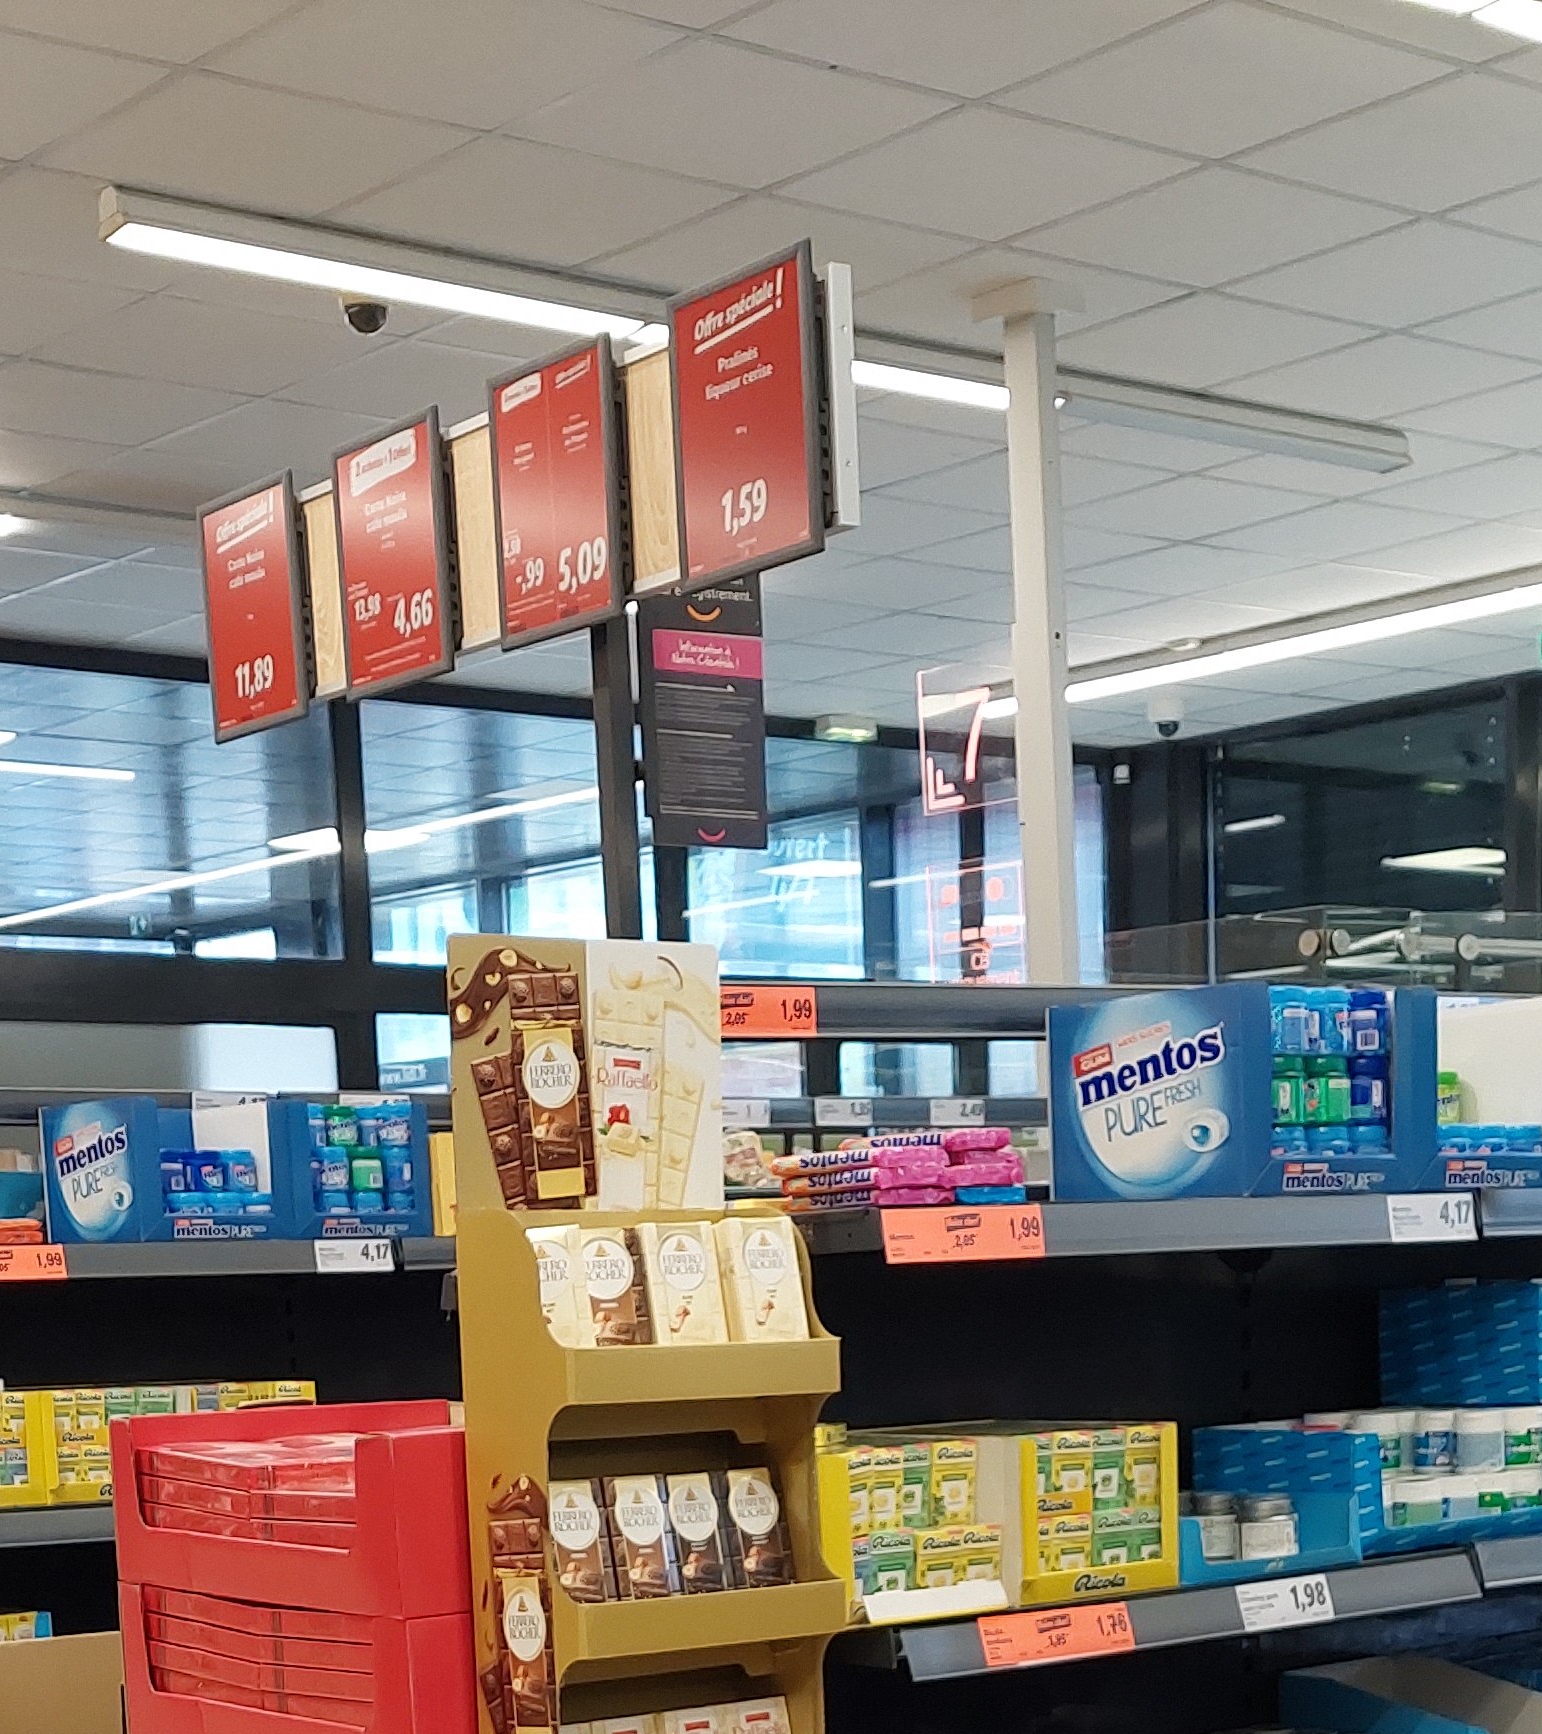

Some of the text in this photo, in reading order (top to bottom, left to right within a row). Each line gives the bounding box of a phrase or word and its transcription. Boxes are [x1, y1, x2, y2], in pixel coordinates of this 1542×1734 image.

[721, 478, 768, 536] 1,59
[558, 537, 607, 593] 5,09
[392, 588, 434, 638] 4,66
[234, 654, 274, 700] 11,89
[955, 686, 992, 782] 7
[781, 998, 813, 1022] 1,99
[596, 1066, 658, 1092] Raffaello
[1079, 1030, 1222, 1107] mentos
[1104, 1077, 1202, 1142] PURE FRESH
[59, 1128, 126, 1178] mentos
[799, 1150, 870, 1169] mentos
[71, 1170, 104, 1205] PURE
[808, 1169, 872, 1188] mentos
[1285, 1171, 1344, 1190] mentos
[1447, 1168, 1501, 1187] mentos
[1439, 1200, 1472, 1228] 4,17
[176, 1226, 229, 1237] mentos
[325, 1225, 373, 1236] mentos
[1009, 1216, 1041, 1241] 1,99
[360, 1242, 390, 1263] 4,17
[62, 1431, 95, 1443] Ricola
[1057, 1437, 1092, 1450] Ricola
[937, 1446, 974, 1461] Ricola
[1055, 1520, 1090, 1534] Ricola
[873, 1531, 1000, 1551] Ricola Ricola Ricola
[1074, 1572, 1127, 1593] Ricola
[1288, 1580, 1327, 1614] 1,98
